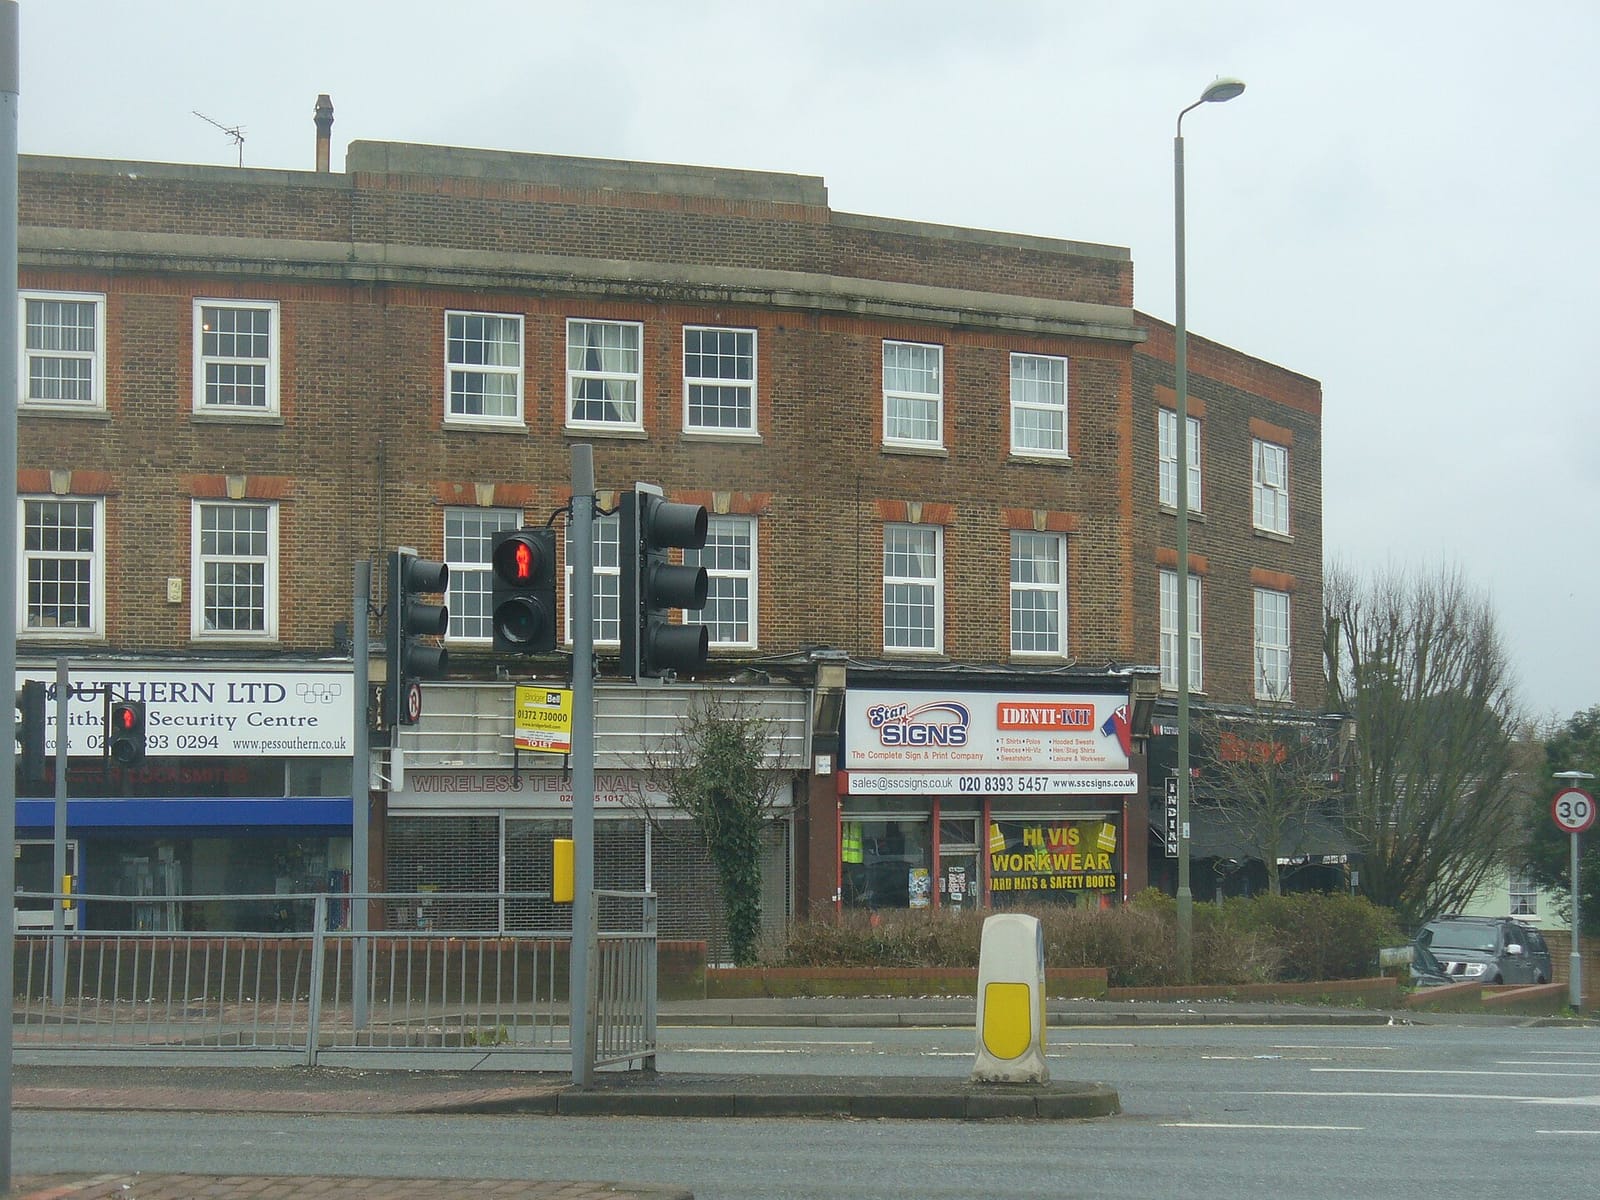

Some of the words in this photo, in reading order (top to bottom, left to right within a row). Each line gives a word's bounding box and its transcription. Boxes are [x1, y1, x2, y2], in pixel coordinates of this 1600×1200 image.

[227, 682, 287, 704] LTD
[149, 711, 237, 731] Security
[247, 712, 318, 727] Centre
[517, 709, 537, 720] 01372
[539, 711, 568, 722] 730000
[868, 704, 907, 726] Star
[1002, 708, 1090, 725] IDENTI-KIT
[176, 735, 219, 749] 0294
[882, 724, 967, 744] SIGNS
[232, 736, 346, 752] www.pessouthern.co.uk
[852, 750, 865, 759] The
[867, 751, 902, 760] Complete
[905, 751, 921, 761] Sign
[932, 751, 948, 759] Print
[951, 752, 984, 761] Company
[412, 775, 524, 793] WIRELESS
[852, 777, 953, 790] sales@sscsigns.co.uk
[959, 776, 980, 791] 020
[984, 776, 1014, 792] 8393
[1018, 777, 1049, 792] 5457
[1053, 778, 1135, 789] www.sscsigns.co.uk
[604, 794, 624, 802] 1017
[1167, 783, 1177, 853] INDIAN
[1559, 801, 1587, 818] 30
[1047, 827, 1080, 846] VIS
[991, 853, 1111, 872] WORKWEAR
[1014, 876, 1038, 890] HATS
[1041, 878, 1048, 889] &
[1050, 875, 1083, 889] SAFETY
[1086, 874, 1116, 888] BOOTS
